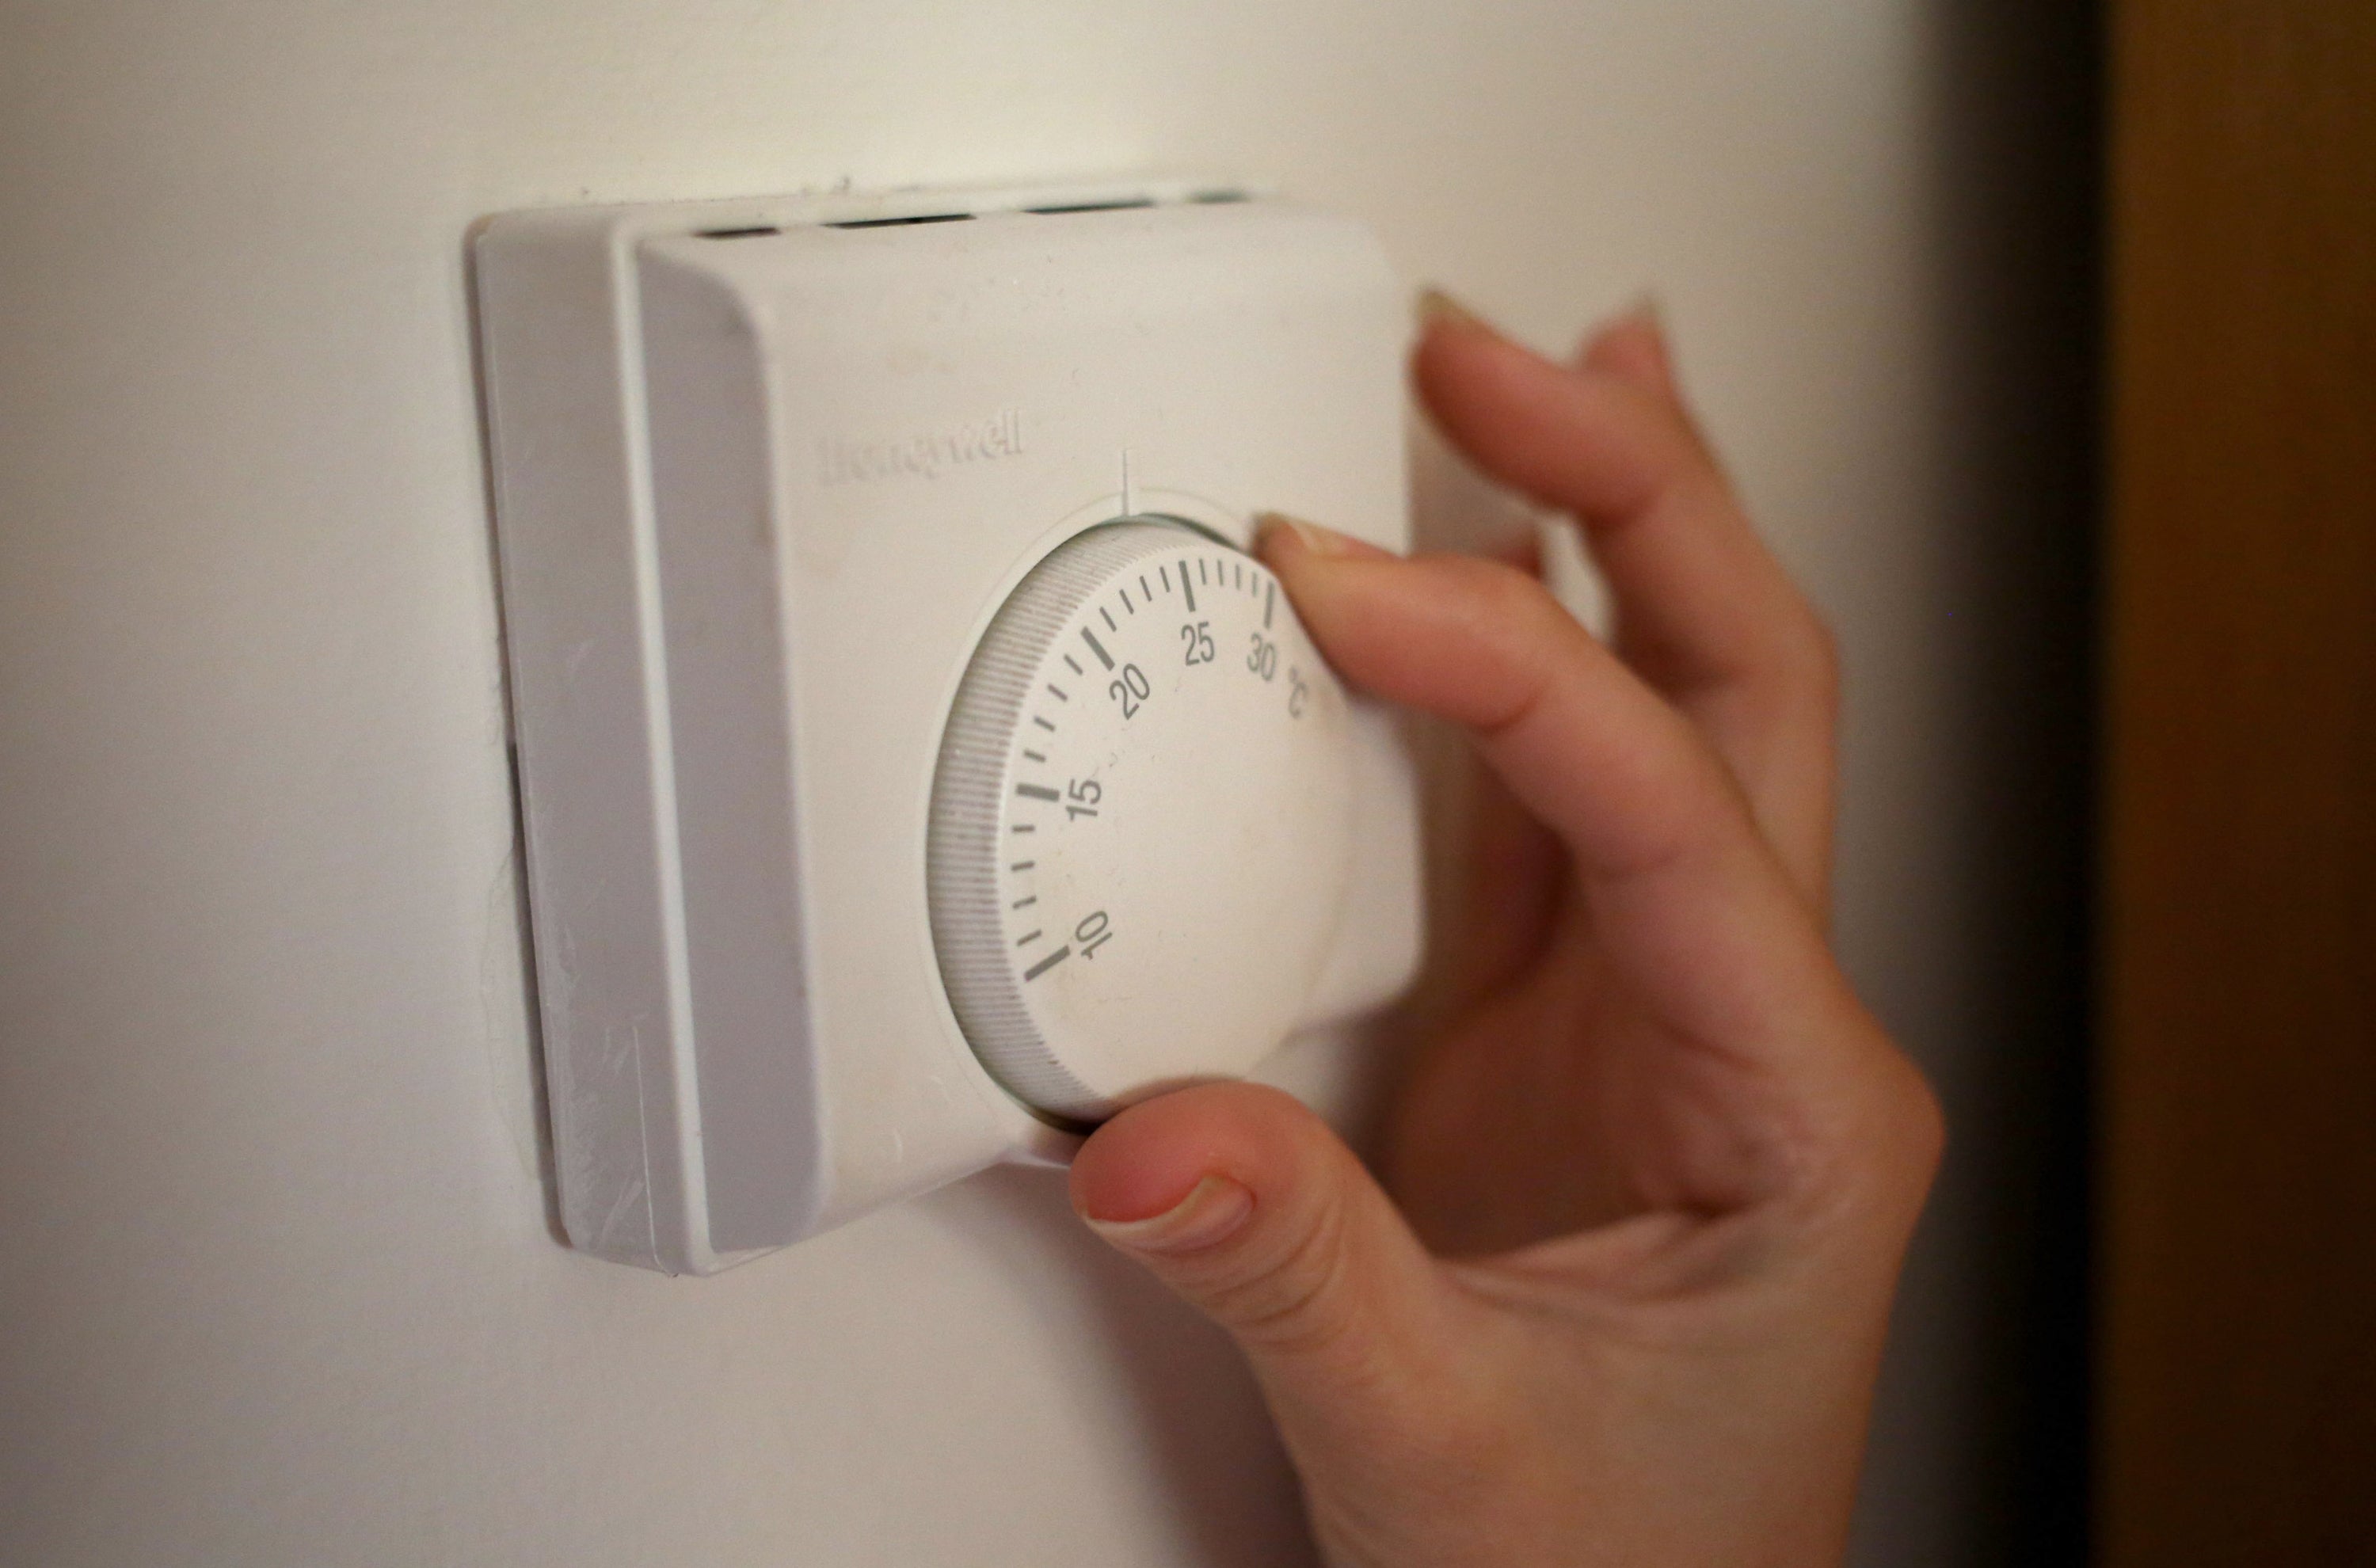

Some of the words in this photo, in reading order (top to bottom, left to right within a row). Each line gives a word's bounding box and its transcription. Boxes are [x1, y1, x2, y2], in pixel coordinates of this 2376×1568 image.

[1181, 621, 1215, 667] 25
[1247, 632, 1276, 682] 30
[1109, 663, 1150, 720] 20
[1288, 666, 1308, 720] °C
[1065, 778, 1102, 821] 15
[1075, 910, 1113, 960] 10
